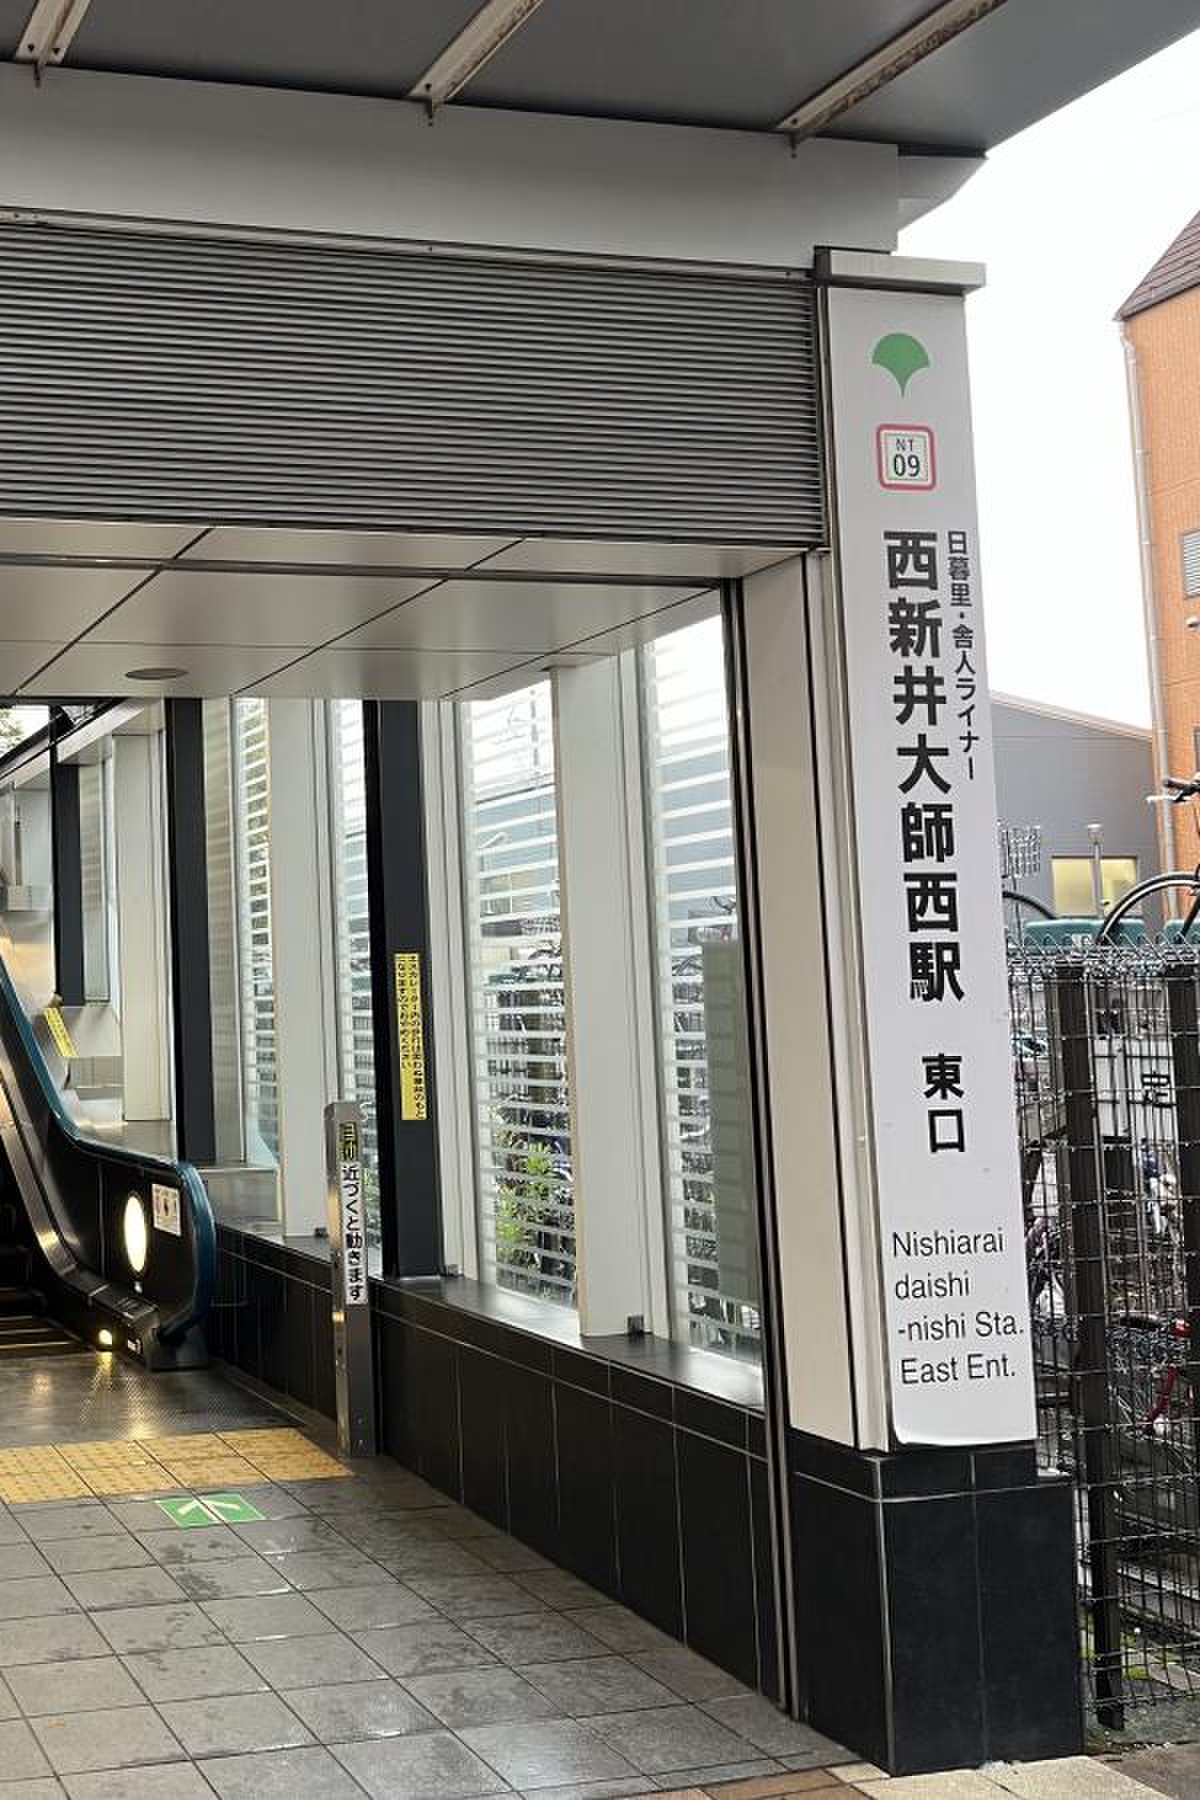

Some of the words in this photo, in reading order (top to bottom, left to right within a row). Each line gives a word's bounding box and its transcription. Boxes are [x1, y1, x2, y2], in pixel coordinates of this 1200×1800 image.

[896, 438, 914, 452] NT
[894, 454, 920, 477] 09
[947, 531, 980, 780] 日暮里・舎人ライナー
[883, 530, 965, 1002] 西新井大師西駅
[921, 1053, 966, 1153] 東口
[342, 1165, 365, 1301] 近づくと動きます
[893, 1227, 1004, 1257] Nishiarai
[895, 1270, 969, 1299] daishi
[898, 1312, 965, 1341] -nishi
[975, 1311, 1024, 1338] Sta.
[901, 1357, 958, 1384] East
[967, 1353, 1015, 1379] Ent.
